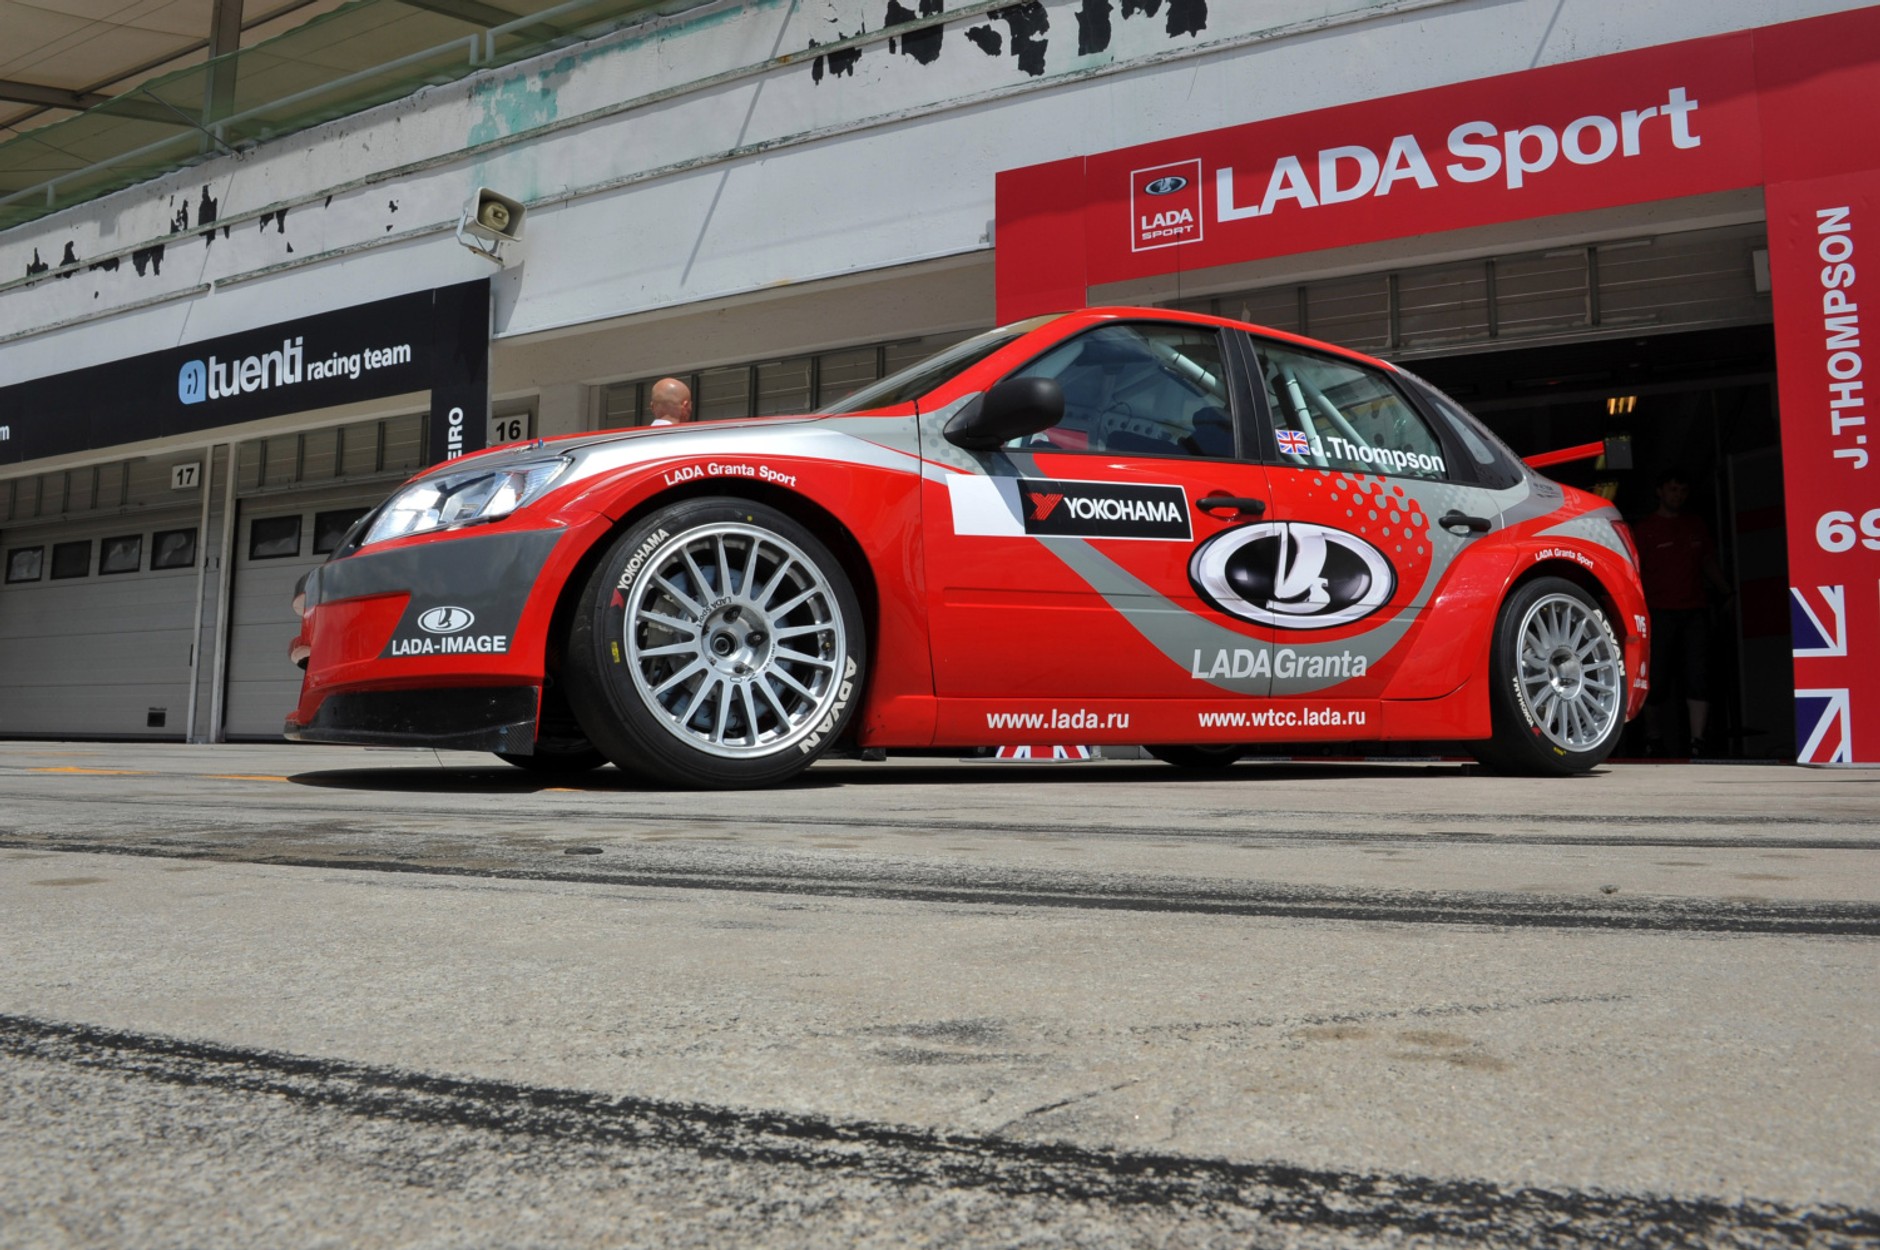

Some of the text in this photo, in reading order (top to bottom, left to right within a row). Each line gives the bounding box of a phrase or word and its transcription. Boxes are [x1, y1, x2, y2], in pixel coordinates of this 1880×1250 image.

[1216, 87, 1701, 223] LADA Sport
[1142, 208, 1193, 230] LADA
[1142, 225, 1193, 240] SPORT
[1816, 206, 1868, 469] J.THOMPSON
[208, 336, 411, 400] tuenti racing team
[496, 420, 521, 442] 16
[1311, 435, 1446, 472] J.Thompson
[177, 467, 195, 485] 17
[664, 462, 797, 487] LADA Granta Sport
[1063, 497, 1183, 523] YOKOHAMA
[616, 528, 670, 590] YOKOHAMA
[1535, 548, 1594, 569] LADA Granta Sport
[392, 635, 507, 656] LADA-IMAGE
[1592, 609, 1625, 676] ADVAN
[799, 655, 857, 754] ADVAN
[1512, 676, 1534, 727] YOKOHAMA
[986, 709, 1130, 729] www.lada.ru
[1198, 707, 1366, 727] www.wtcc.lada.ru
